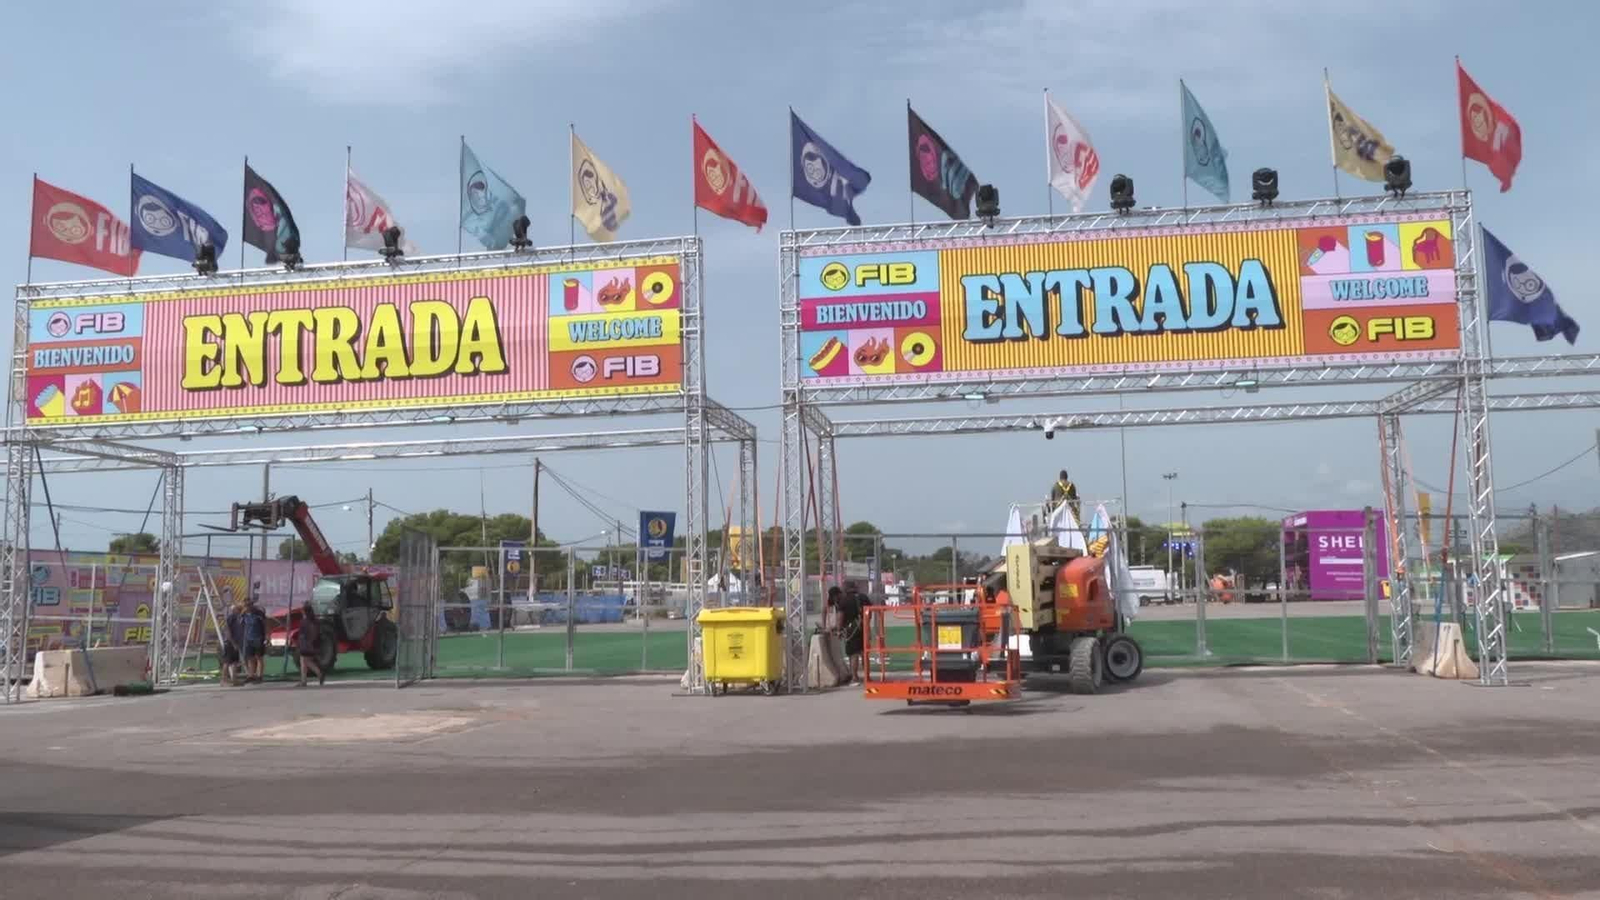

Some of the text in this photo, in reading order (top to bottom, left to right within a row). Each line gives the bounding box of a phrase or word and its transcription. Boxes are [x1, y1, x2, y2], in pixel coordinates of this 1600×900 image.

[854, 262, 916, 287] FIB
[960, 258, 1285, 343] ENTRADA
[1329, 275, 1429, 301] WELCOME
[75, 311, 125, 334] FIB
[816, 299, 927, 325] BIENVENIDO
[568, 316, 663, 343] WELCOME
[1367, 315, 1436, 343] FIB
[33, 344, 134, 368] BIENVENIDO
[181, 296, 509, 391] ENTRADA
[603, 355, 661, 379] FIB
[1319, 535, 1364, 549] SHEI
[908, 684, 963, 696] mateco
